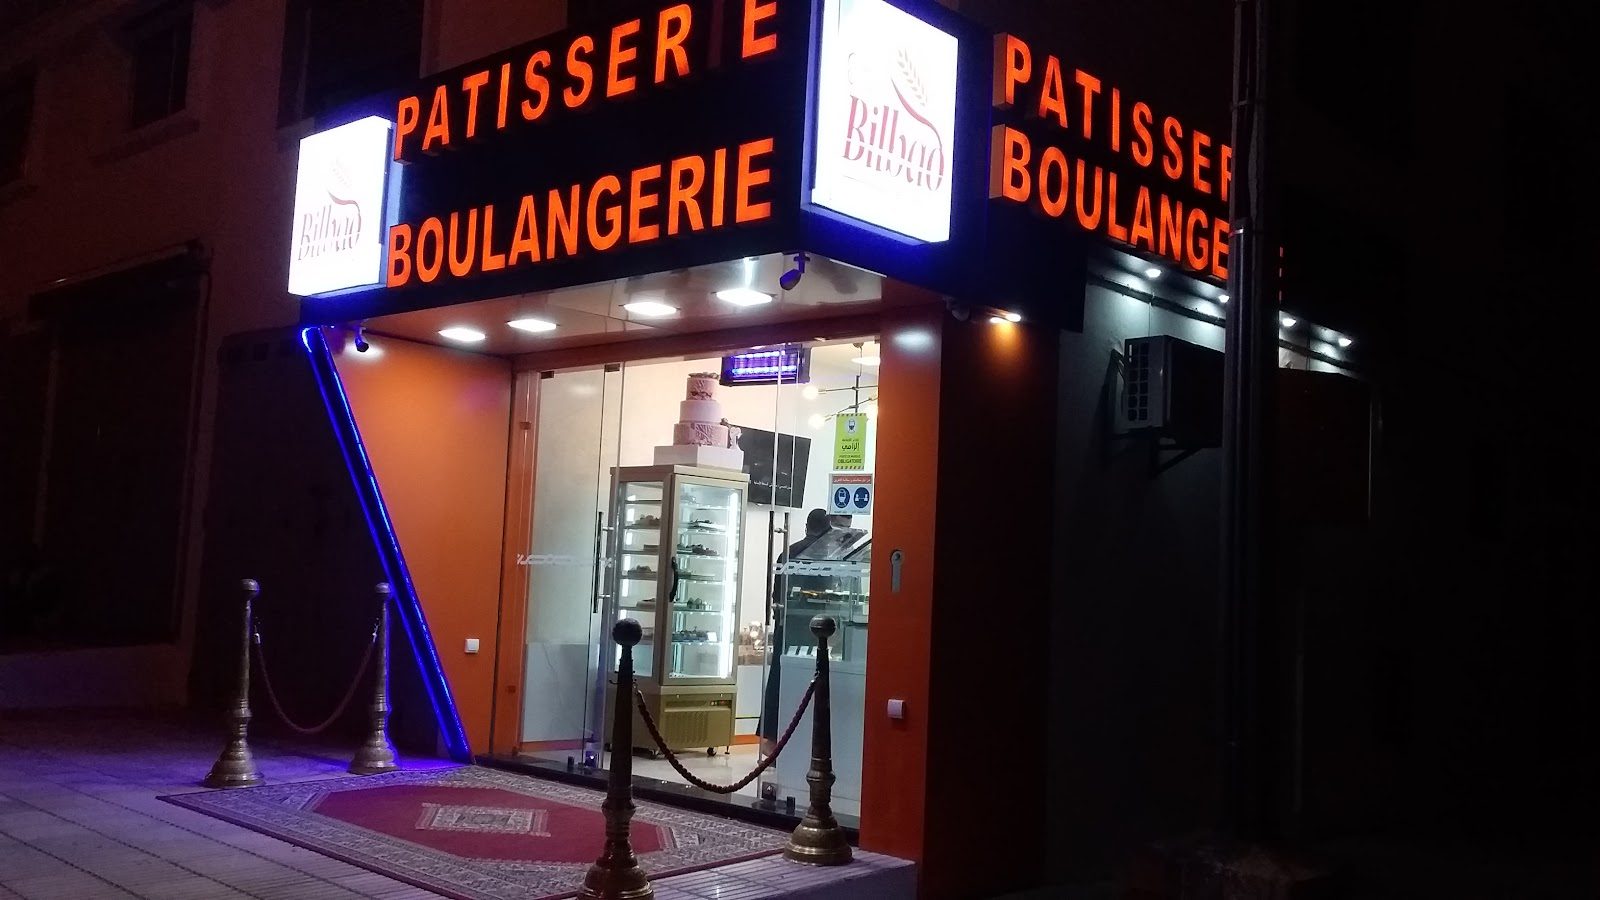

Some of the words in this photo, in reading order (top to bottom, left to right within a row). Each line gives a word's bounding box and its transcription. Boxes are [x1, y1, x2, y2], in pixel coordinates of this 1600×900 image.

[387, 138, 775, 288] BOULANGERIE
[842, 94, 945, 191] Bilbao
[1003, 126, 1283, 303] BOULANGE
